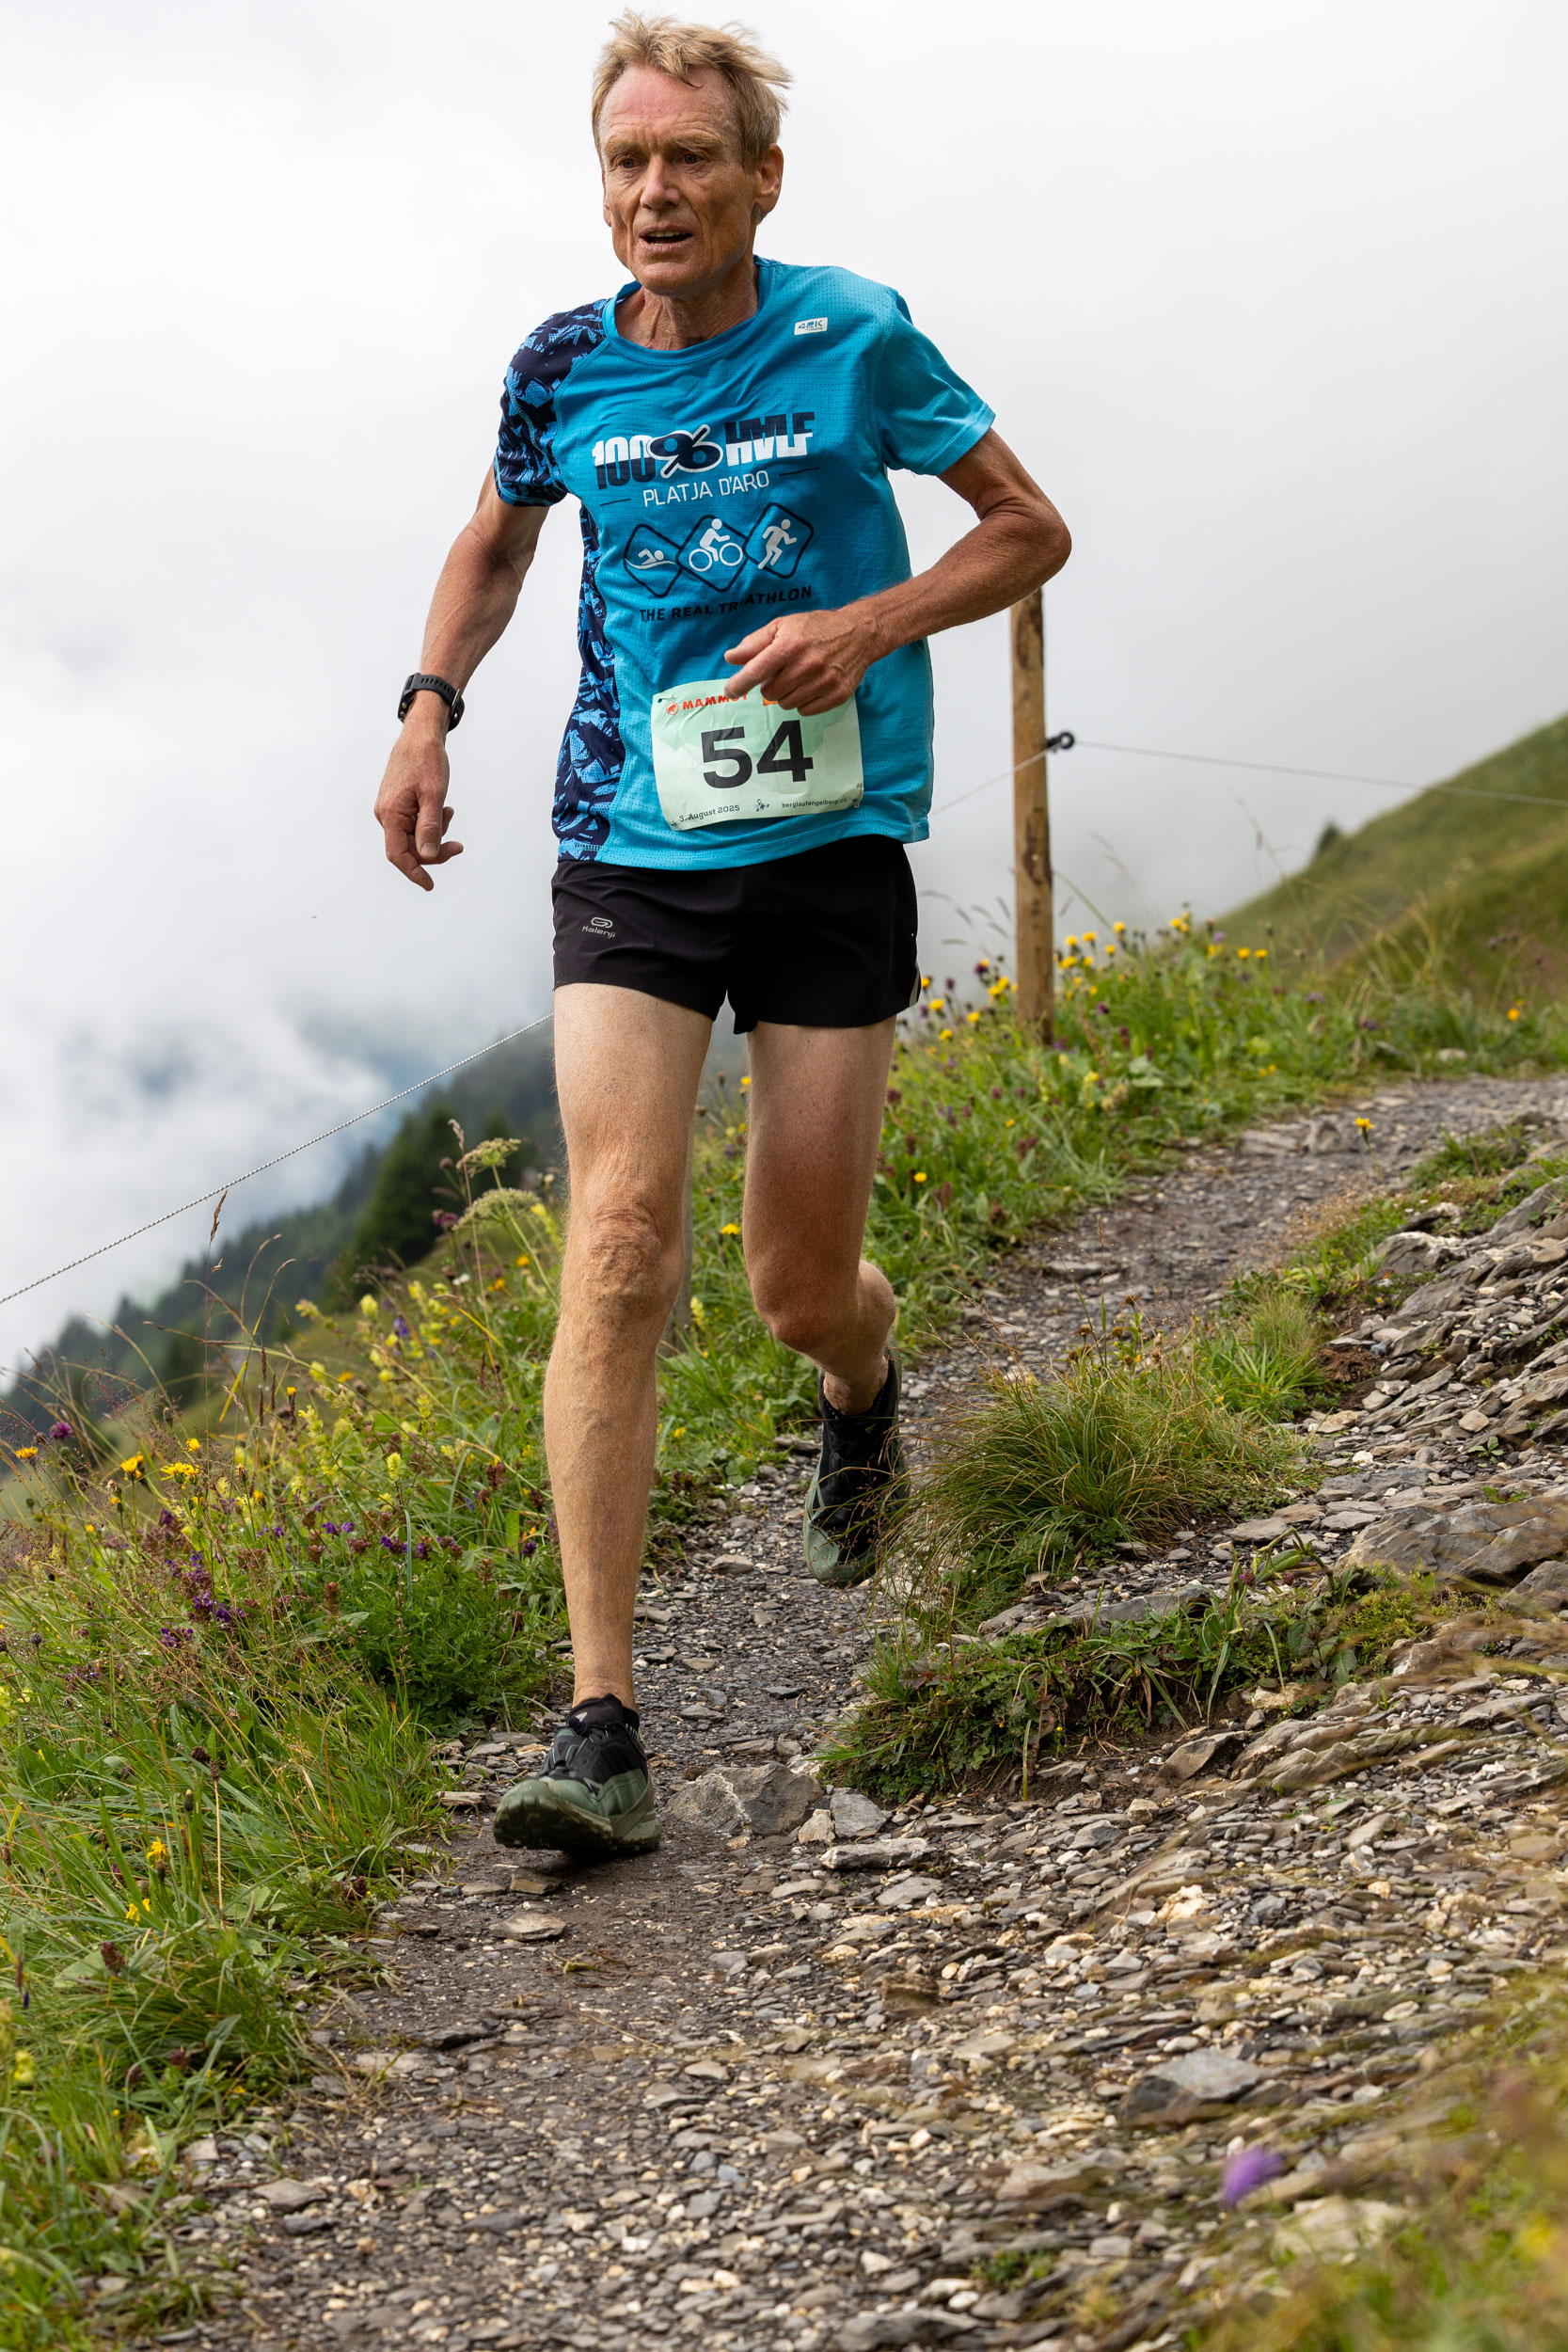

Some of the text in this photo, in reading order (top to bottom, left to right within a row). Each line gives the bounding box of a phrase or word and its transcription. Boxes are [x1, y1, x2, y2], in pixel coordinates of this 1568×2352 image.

[642, 469, 770, 507] PLATJA D'ARO
[639, 584, 813, 622] THE REAL TRIATHLON
[701, 719, 814, 789] 54
[688, 808, 716, 820] August
[718, 804, 740, 814] 2025
[782, 797, 847, 809] berglaufengelberg.ch
